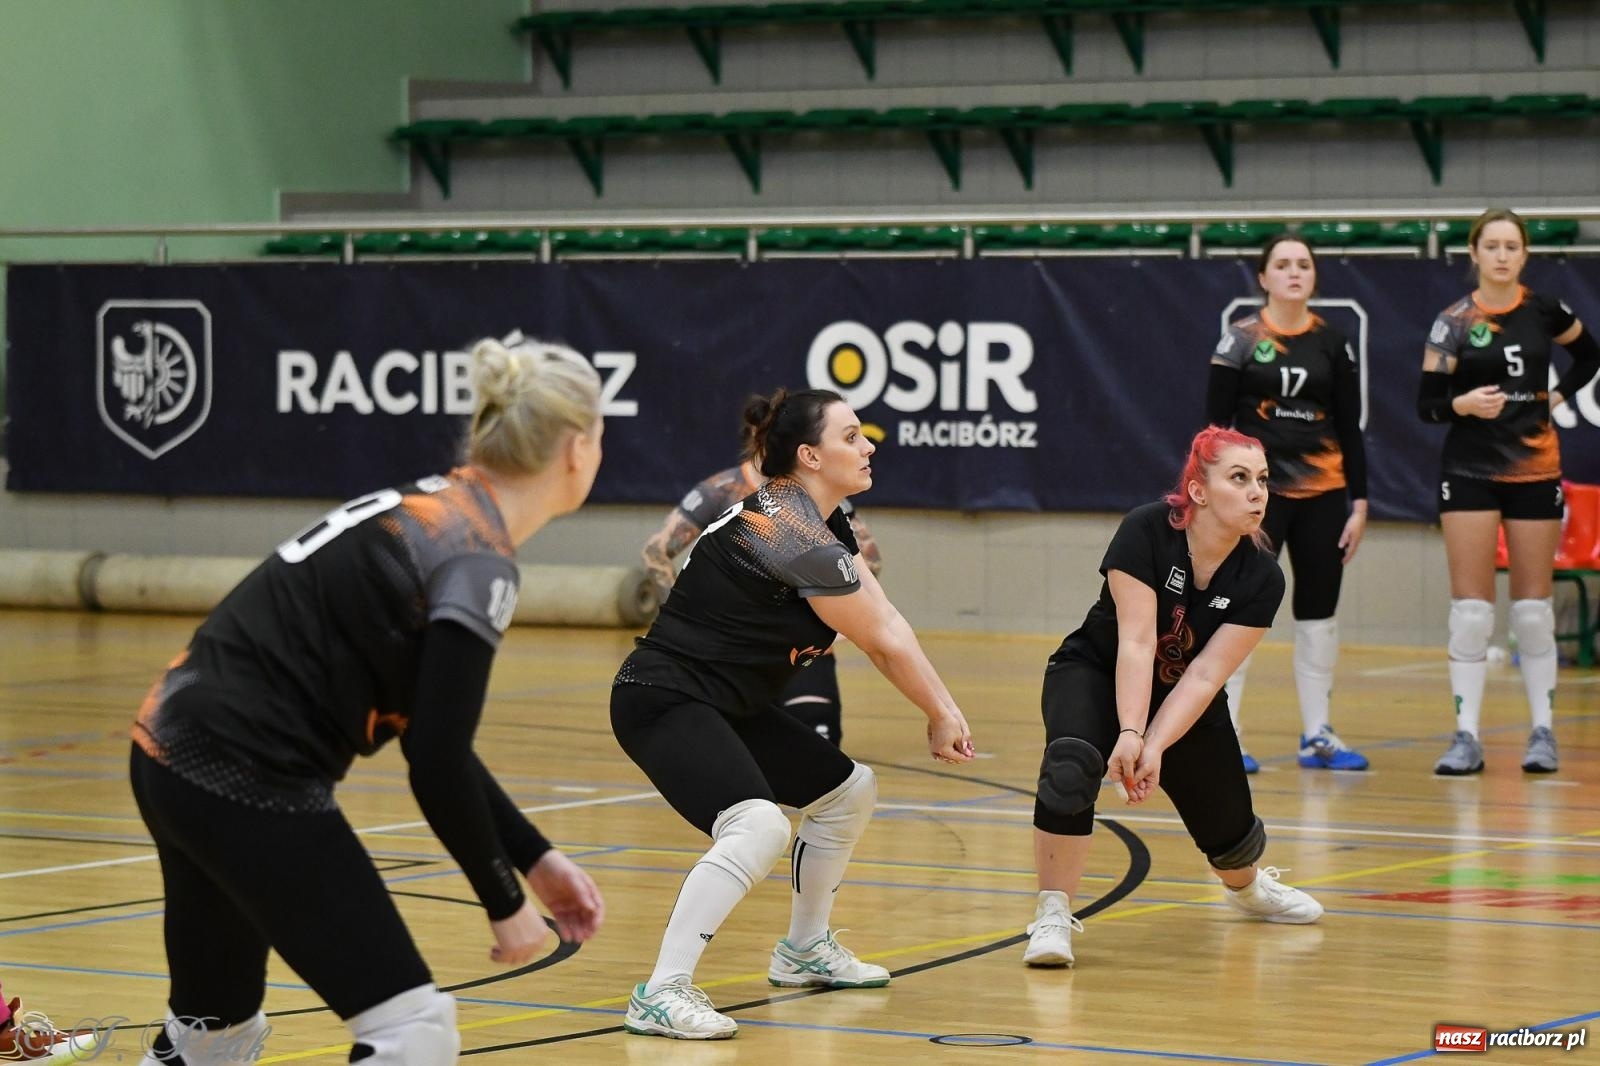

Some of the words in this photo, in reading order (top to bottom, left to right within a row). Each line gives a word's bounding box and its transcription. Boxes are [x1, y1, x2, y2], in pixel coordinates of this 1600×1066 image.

[276, 330, 639, 417] RACIBZ
[806, 319, 1038, 412] OSiR
[1503, 344, 1525, 377] 5
[1280, 366, 1308, 398] 17
[897, 414, 1038, 448] RACIBÓRZ
